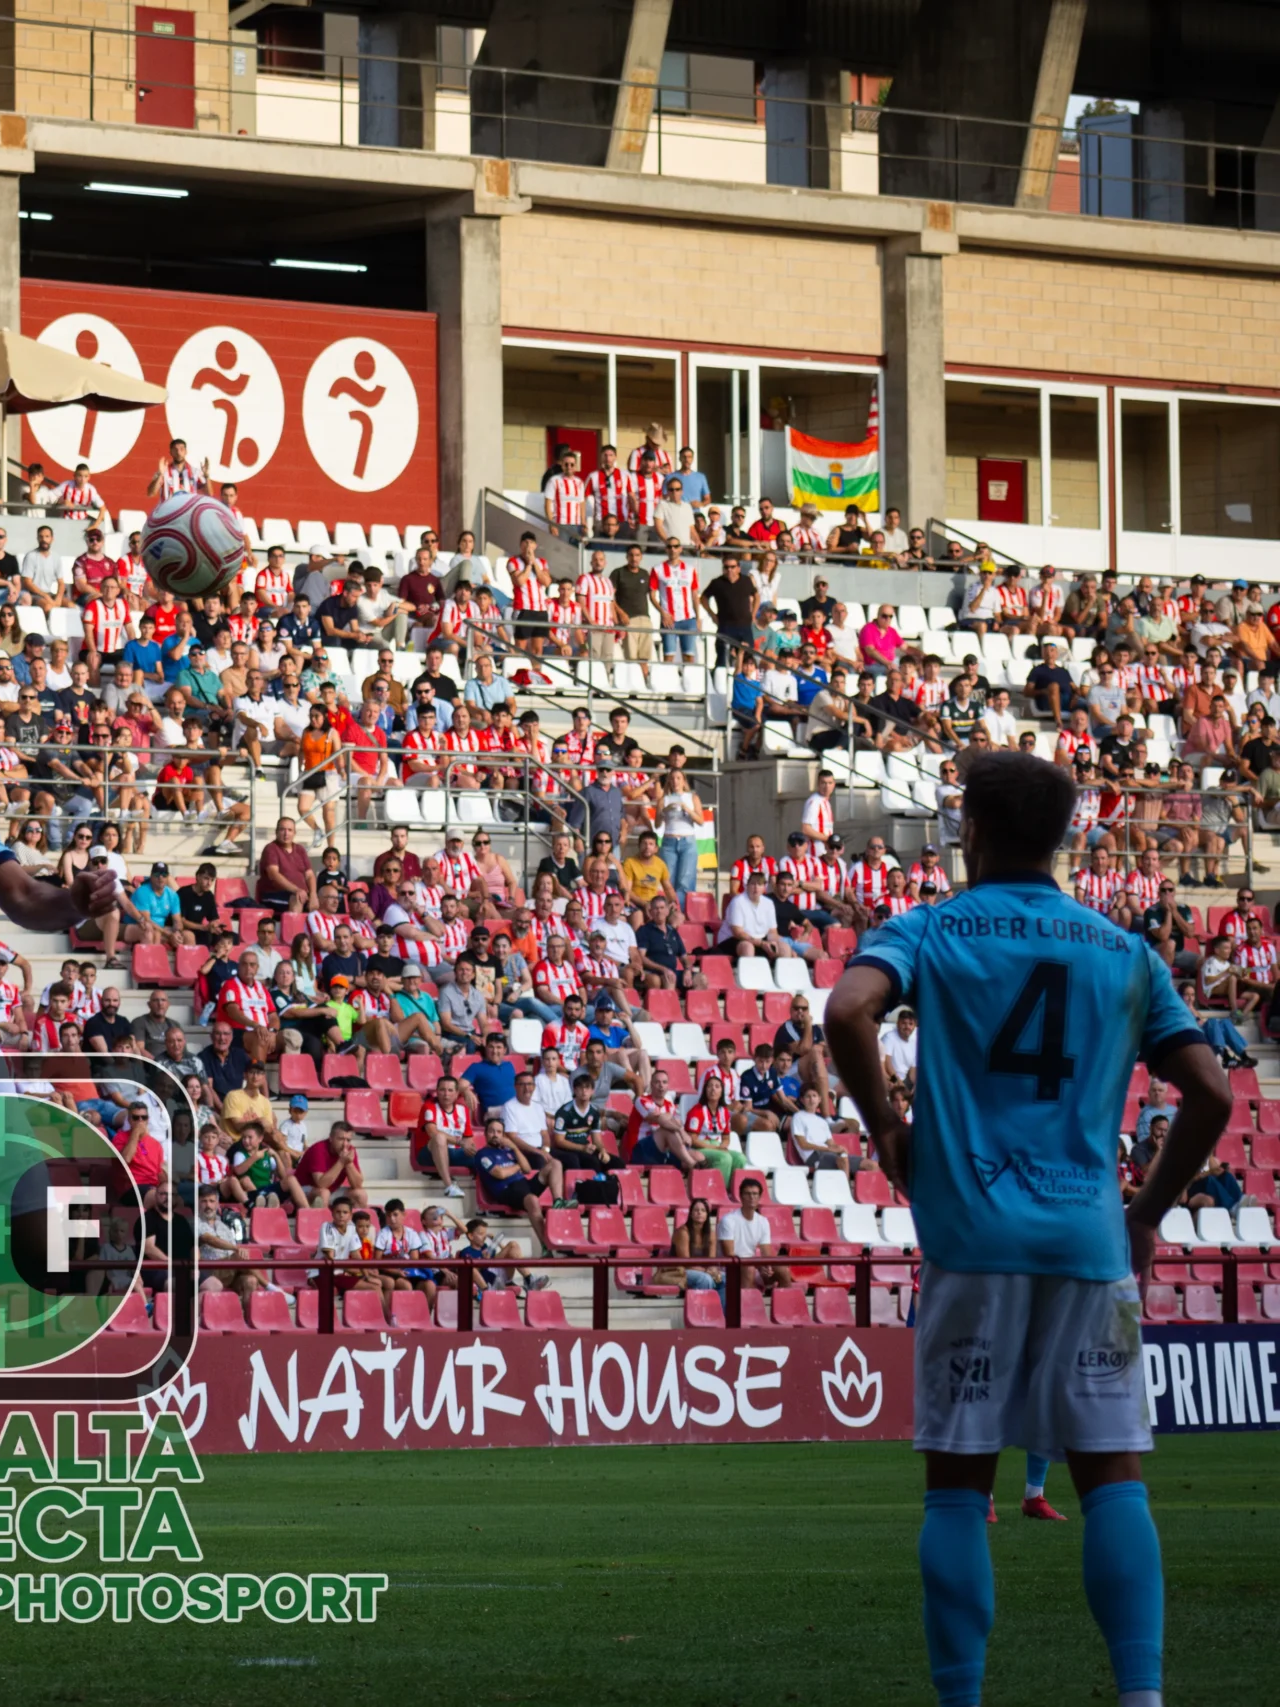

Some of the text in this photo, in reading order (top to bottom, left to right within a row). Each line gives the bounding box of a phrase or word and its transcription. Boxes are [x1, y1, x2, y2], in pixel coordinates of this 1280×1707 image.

[940, 914, 1131, 953] ROBER CORREA
[986, 959, 1078, 1104] 4
[238, 1332, 791, 1450] NATUR HOUSE
[1142, 1341, 1280, 1426] PRIME
